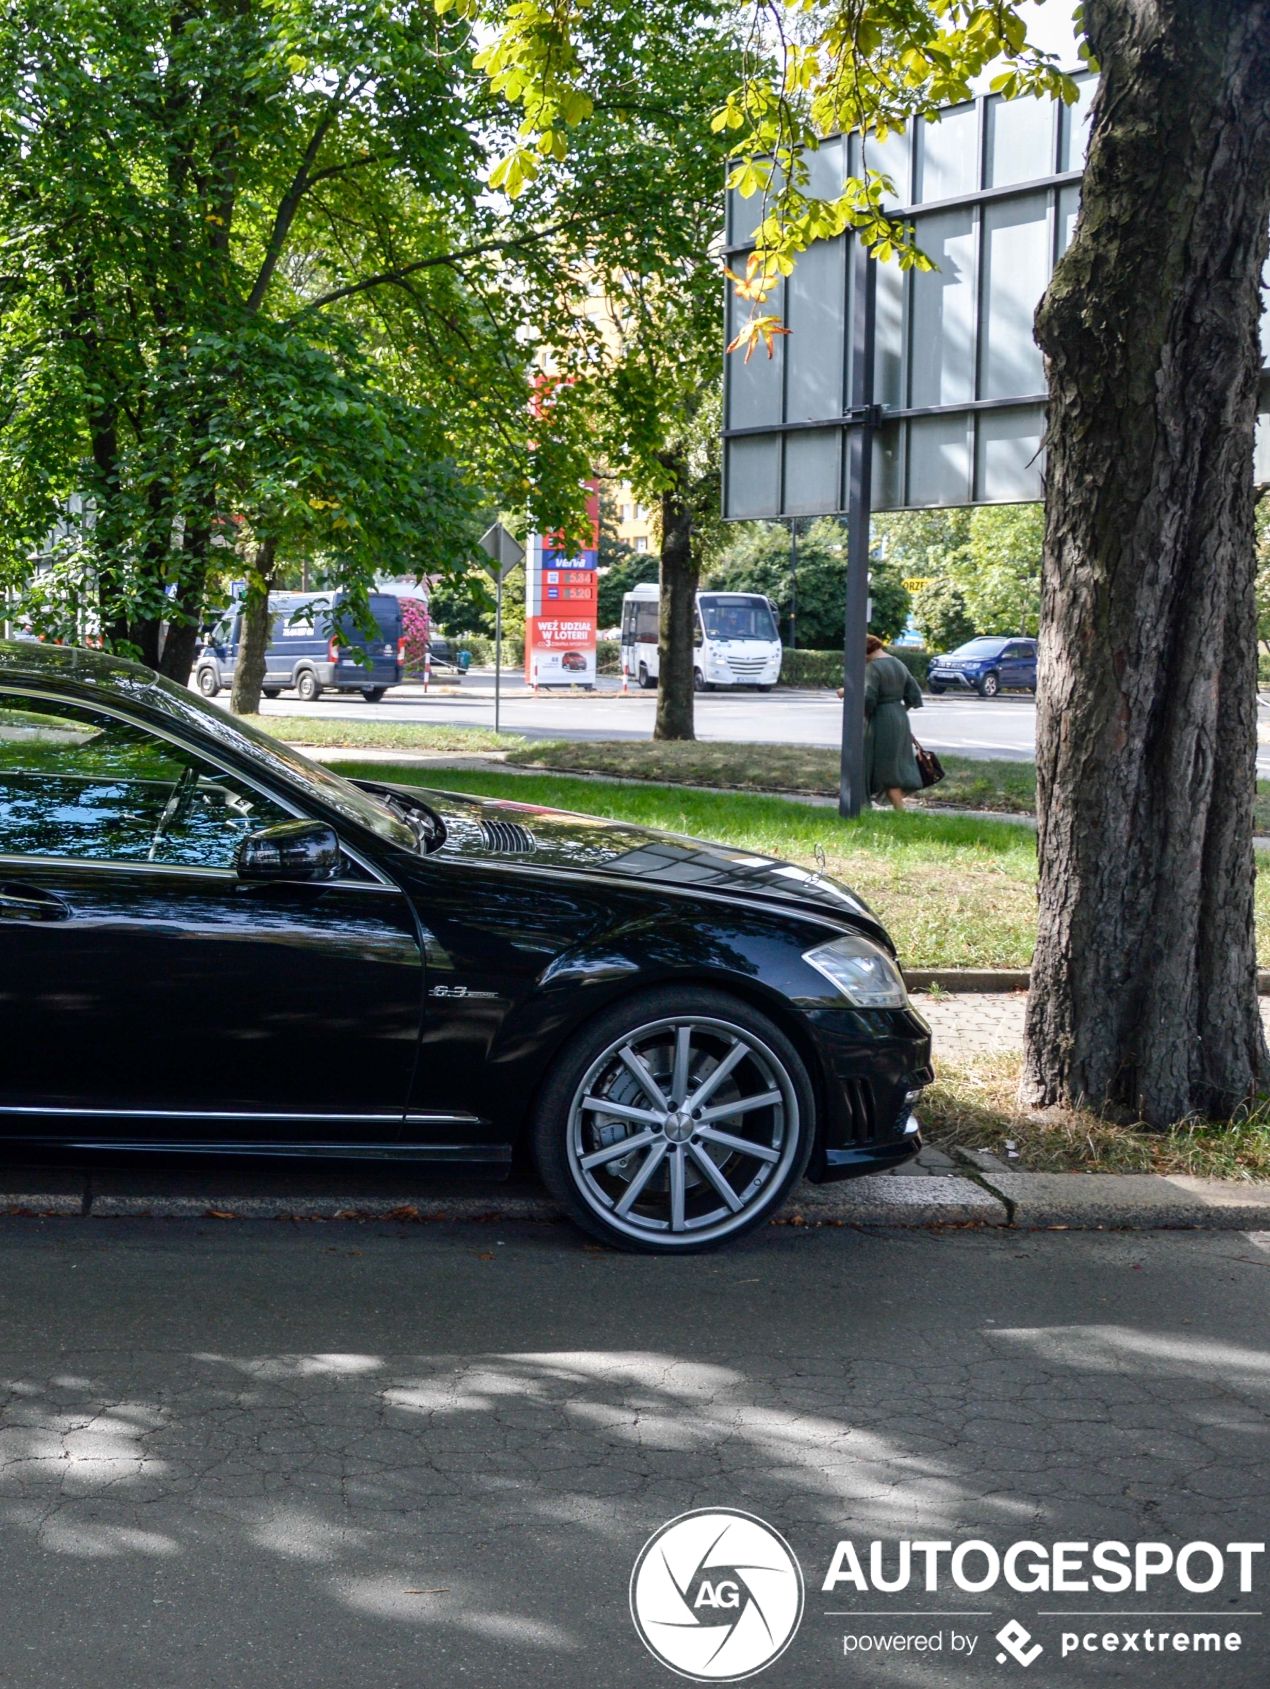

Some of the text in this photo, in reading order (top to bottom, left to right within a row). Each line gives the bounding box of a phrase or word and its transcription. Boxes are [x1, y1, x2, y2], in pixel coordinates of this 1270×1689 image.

[569, 588, 591, 599] 5.20
[537, 619, 592, 631] WEŹ UDZIAŁ
[541, 631, 588, 640] W LOTERII
